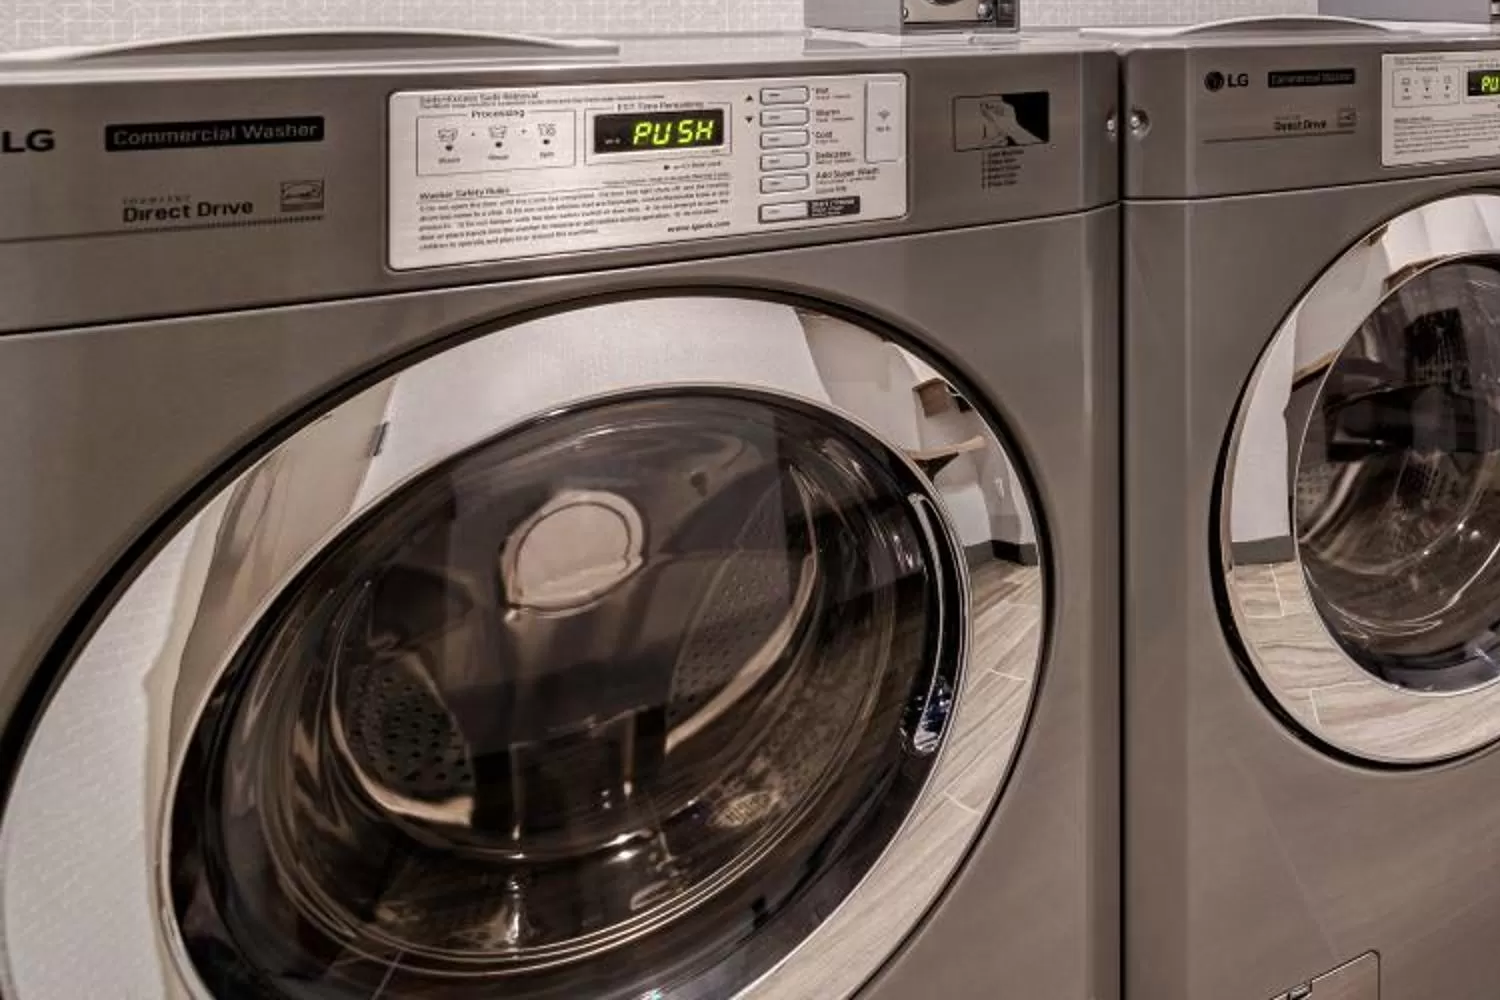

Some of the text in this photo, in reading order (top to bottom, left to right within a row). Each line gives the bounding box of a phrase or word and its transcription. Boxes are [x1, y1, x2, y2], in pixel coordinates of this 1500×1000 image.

[1227, 73, 1249, 88] LG
[1, 128, 56, 153] LG
[113, 123, 319, 147] Commercial Washer
[632, 119, 715, 146] PUSH
[122, 203, 191, 224] Direct
[197, 199, 254, 218] Drive
